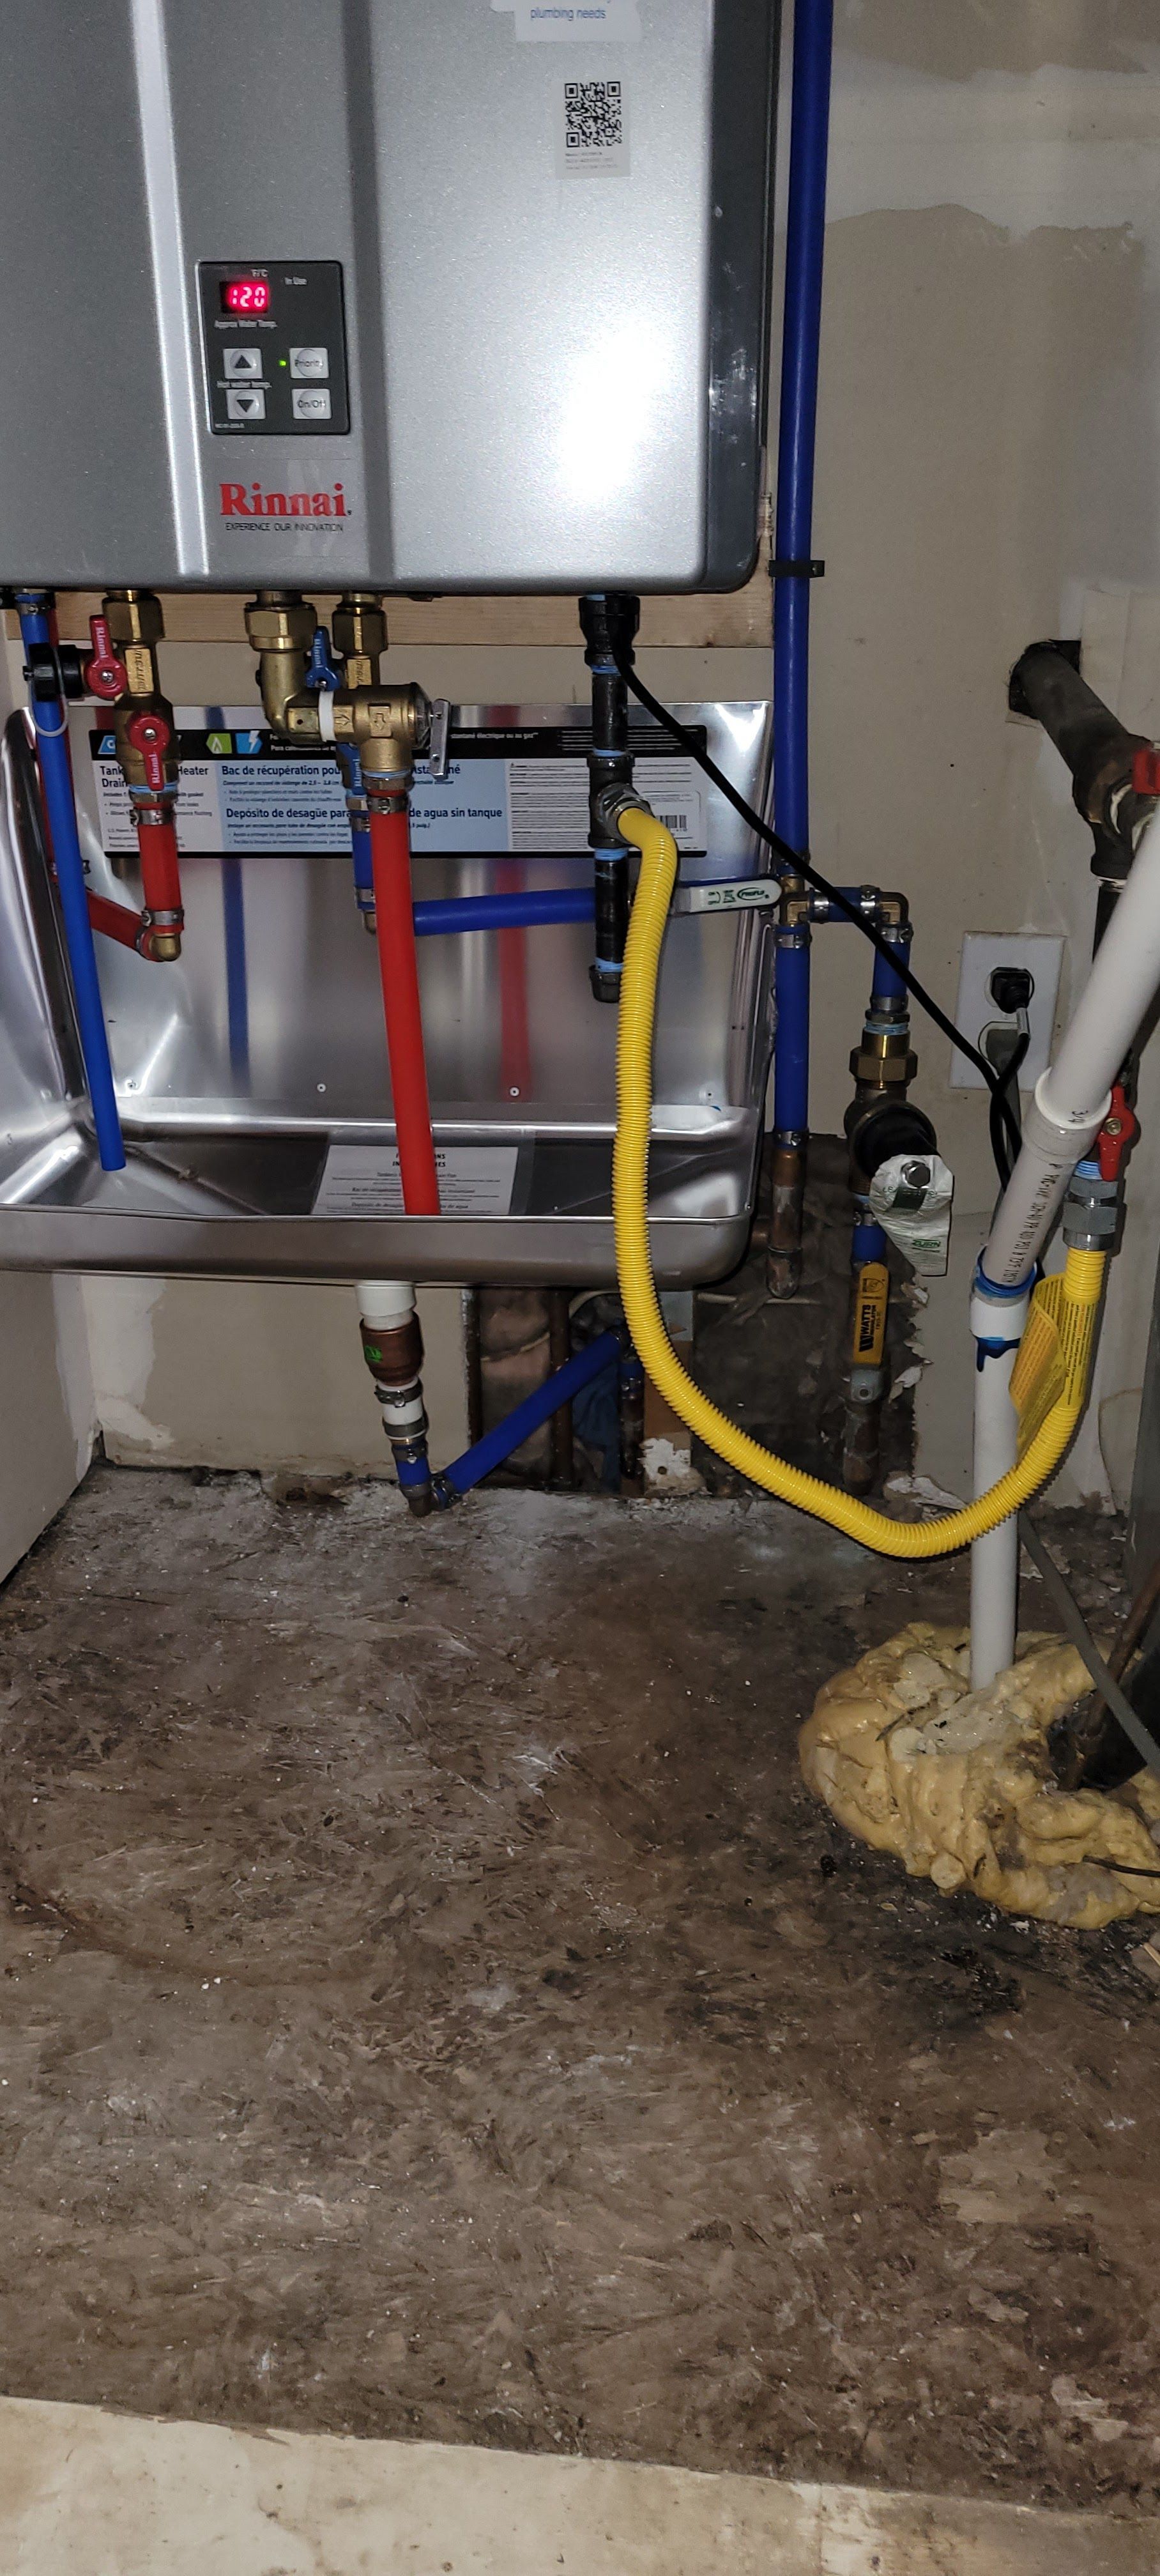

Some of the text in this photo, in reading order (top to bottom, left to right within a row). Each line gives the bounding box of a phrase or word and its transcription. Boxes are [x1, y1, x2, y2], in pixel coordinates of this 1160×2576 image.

[530, 7, 606, 21] plumbing needs
[233, 287, 265, 307] 120
[220, 482, 347, 517] Rinnai
[225, 523, 343, 532] EXPERIENCE OUR INNOVATION
[222, 766, 240, 776] Bac
[242, 765, 254, 776] de
[257, 765, 319, 777] récupération
[322, 767, 340, 777] pou
[226, 808, 269, 819] Depósito
[271, 808, 284, 818] de
[287, 808, 328, 820] desagüe
[424, 809, 448, 820] agua
[451, 808, 465, 817] sin
[468, 808, 503, 820] tanque
[861, 1304, 871, 1335] WATTS
